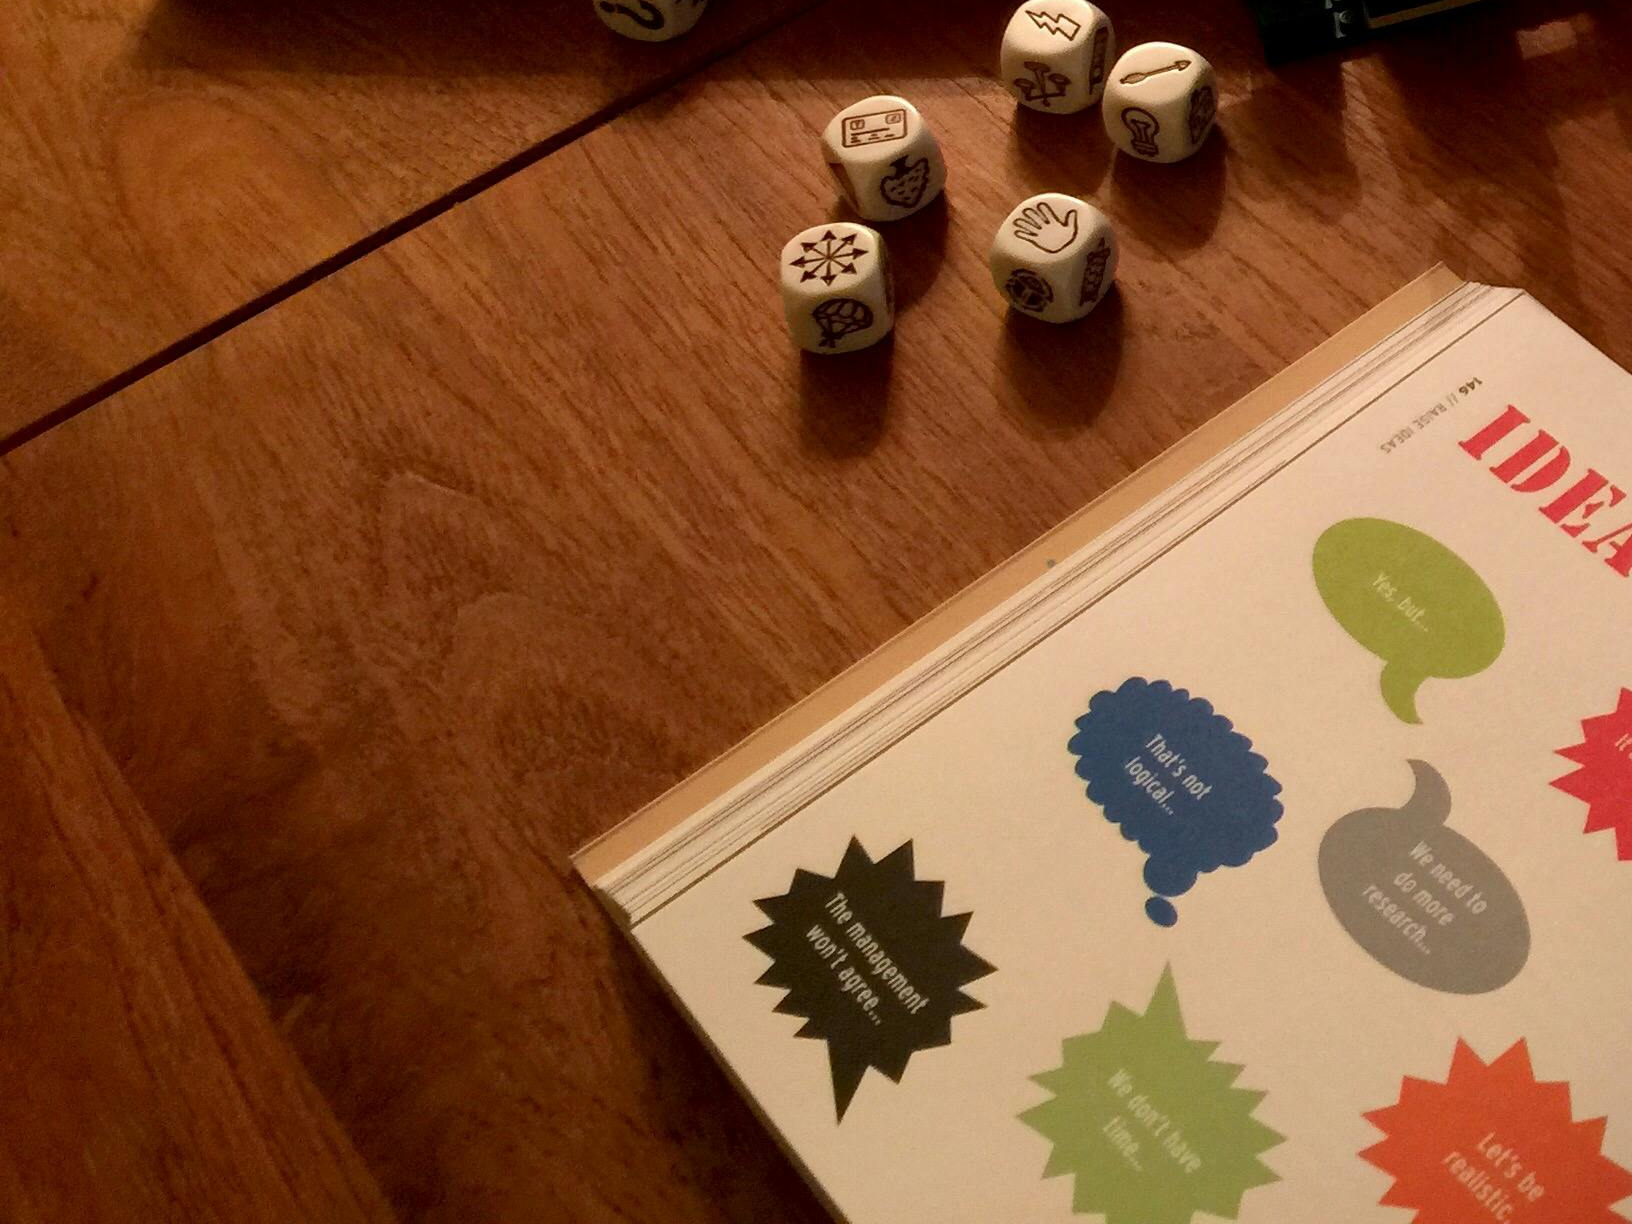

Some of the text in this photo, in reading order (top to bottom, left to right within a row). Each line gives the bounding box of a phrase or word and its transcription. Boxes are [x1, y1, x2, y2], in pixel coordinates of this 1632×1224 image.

[1411, 402, 1448, 430] RAISE
[1458, 376, 1483, 396] 146
[1380, 425, 1415, 454] IDEAS
[1124, 755, 1176, 816] logical...
[1145, 733, 1213, 801] That's not
[1393, 872, 1456, 926] do more
[1408, 839, 1488, 915] We need to
[824, 891, 930, 1015] The management
[1362, 883, 1431, 955] research...
[805, 924, 881, 1026] won't agree...
[1127, 1094, 1171, 1137] don't
[1162, 1129, 1202, 1175] have
[1477, 1130, 1545, 1202] Let's be
